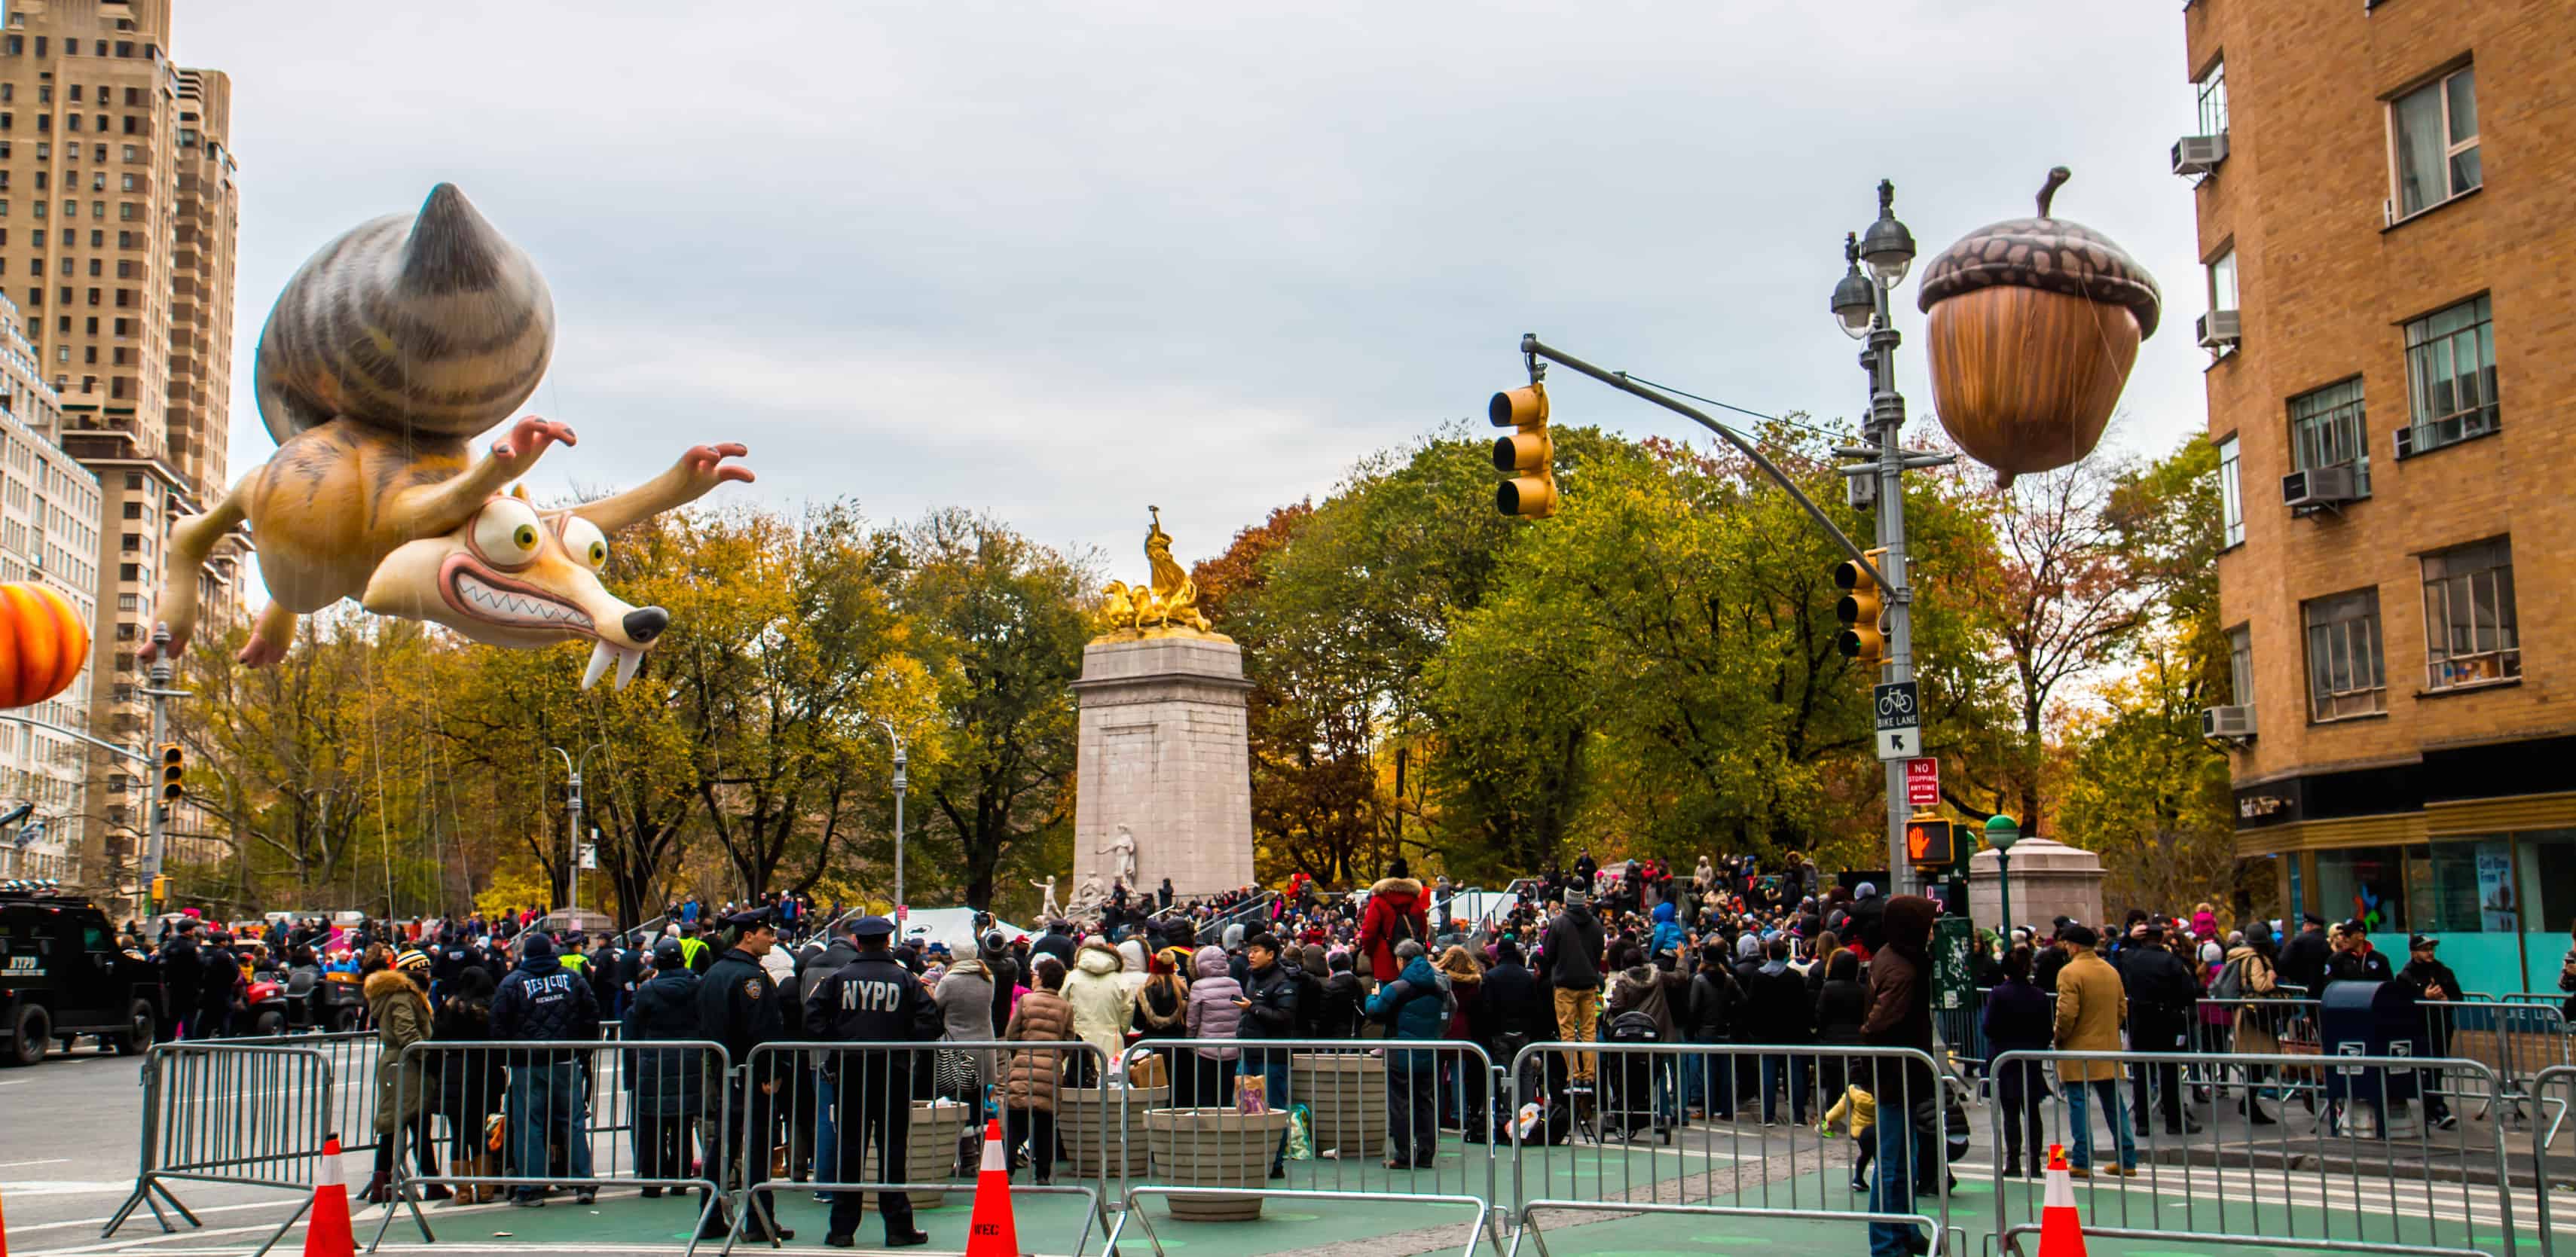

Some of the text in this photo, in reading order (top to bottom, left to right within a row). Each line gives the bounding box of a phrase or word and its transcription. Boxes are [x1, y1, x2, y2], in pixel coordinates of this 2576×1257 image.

[1877, 715, 1917, 728] BIKE LANE
[1914, 764, 1929, 773] NO
[9, 956, 37, 969] NYPD
[842, 980, 900, 1012] NYPD
[974, 1223, 1000, 1236] WEC
